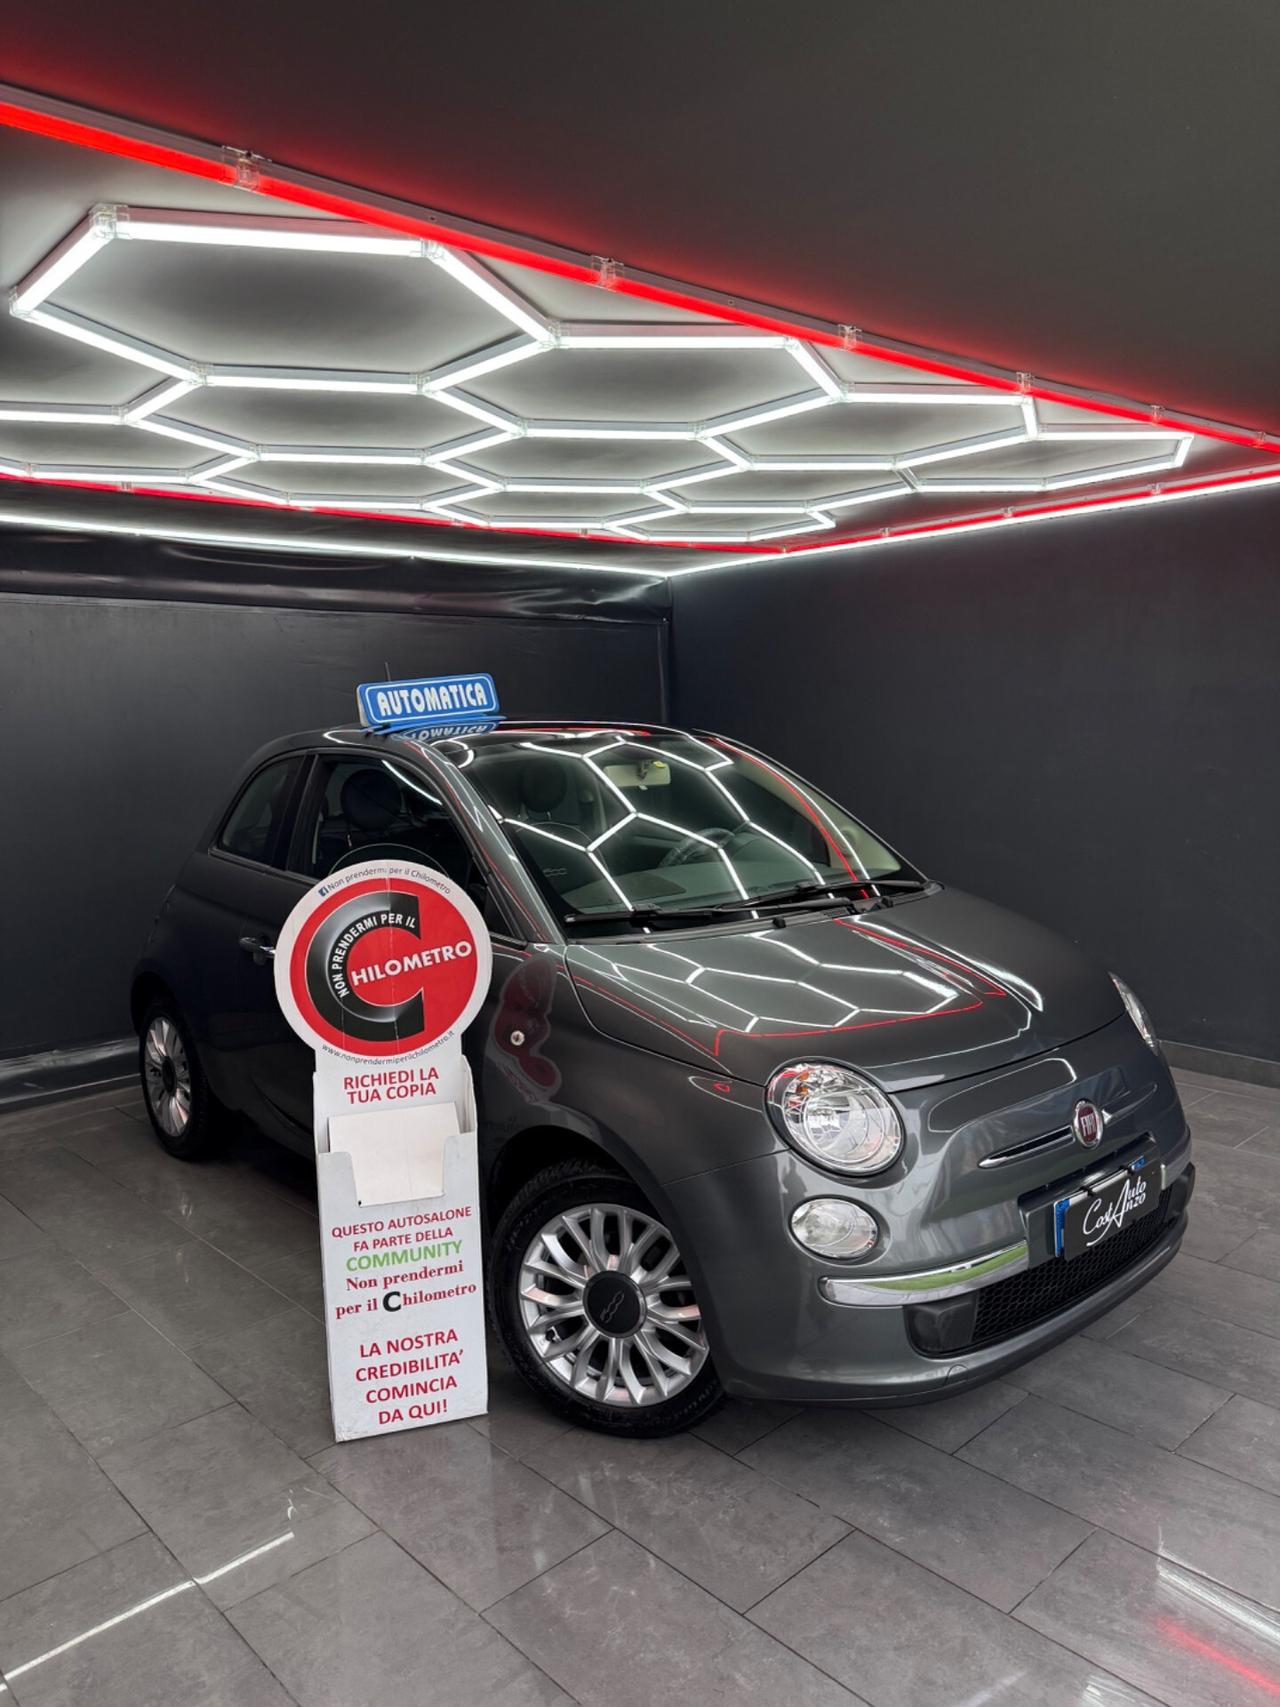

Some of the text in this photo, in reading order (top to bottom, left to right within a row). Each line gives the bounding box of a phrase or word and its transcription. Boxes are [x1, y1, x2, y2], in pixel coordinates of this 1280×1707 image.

[376, 682, 488, 717] AUTOMATICA
[327, 878, 345, 891] Non
[388, 867, 402, 875] per
[411, 869, 451, 895] Chilometro
[332, 913, 416, 998] NON PRENDERMI PER IL
[343, 1067, 439, 1090] RICHIEDI LA
[347, 1082, 437, 1105] TUA COPIA
[331, 1206, 473, 1238] QUESTO AUTOSALONE
[353, 1227, 454, 1252] FA PARTE DELLA
[346, 1240, 463, 1272] COMMUNITY
[345, 1260, 465, 1292] Non prendermi
[335, 1283, 477, 1320] per il Chilometro
[360, 1328, 459, 1358] LA NOSTRA
[366, 1375, 458, 1404] COMINCIA
[378, 1399, 448, 1425] DA QUI!
